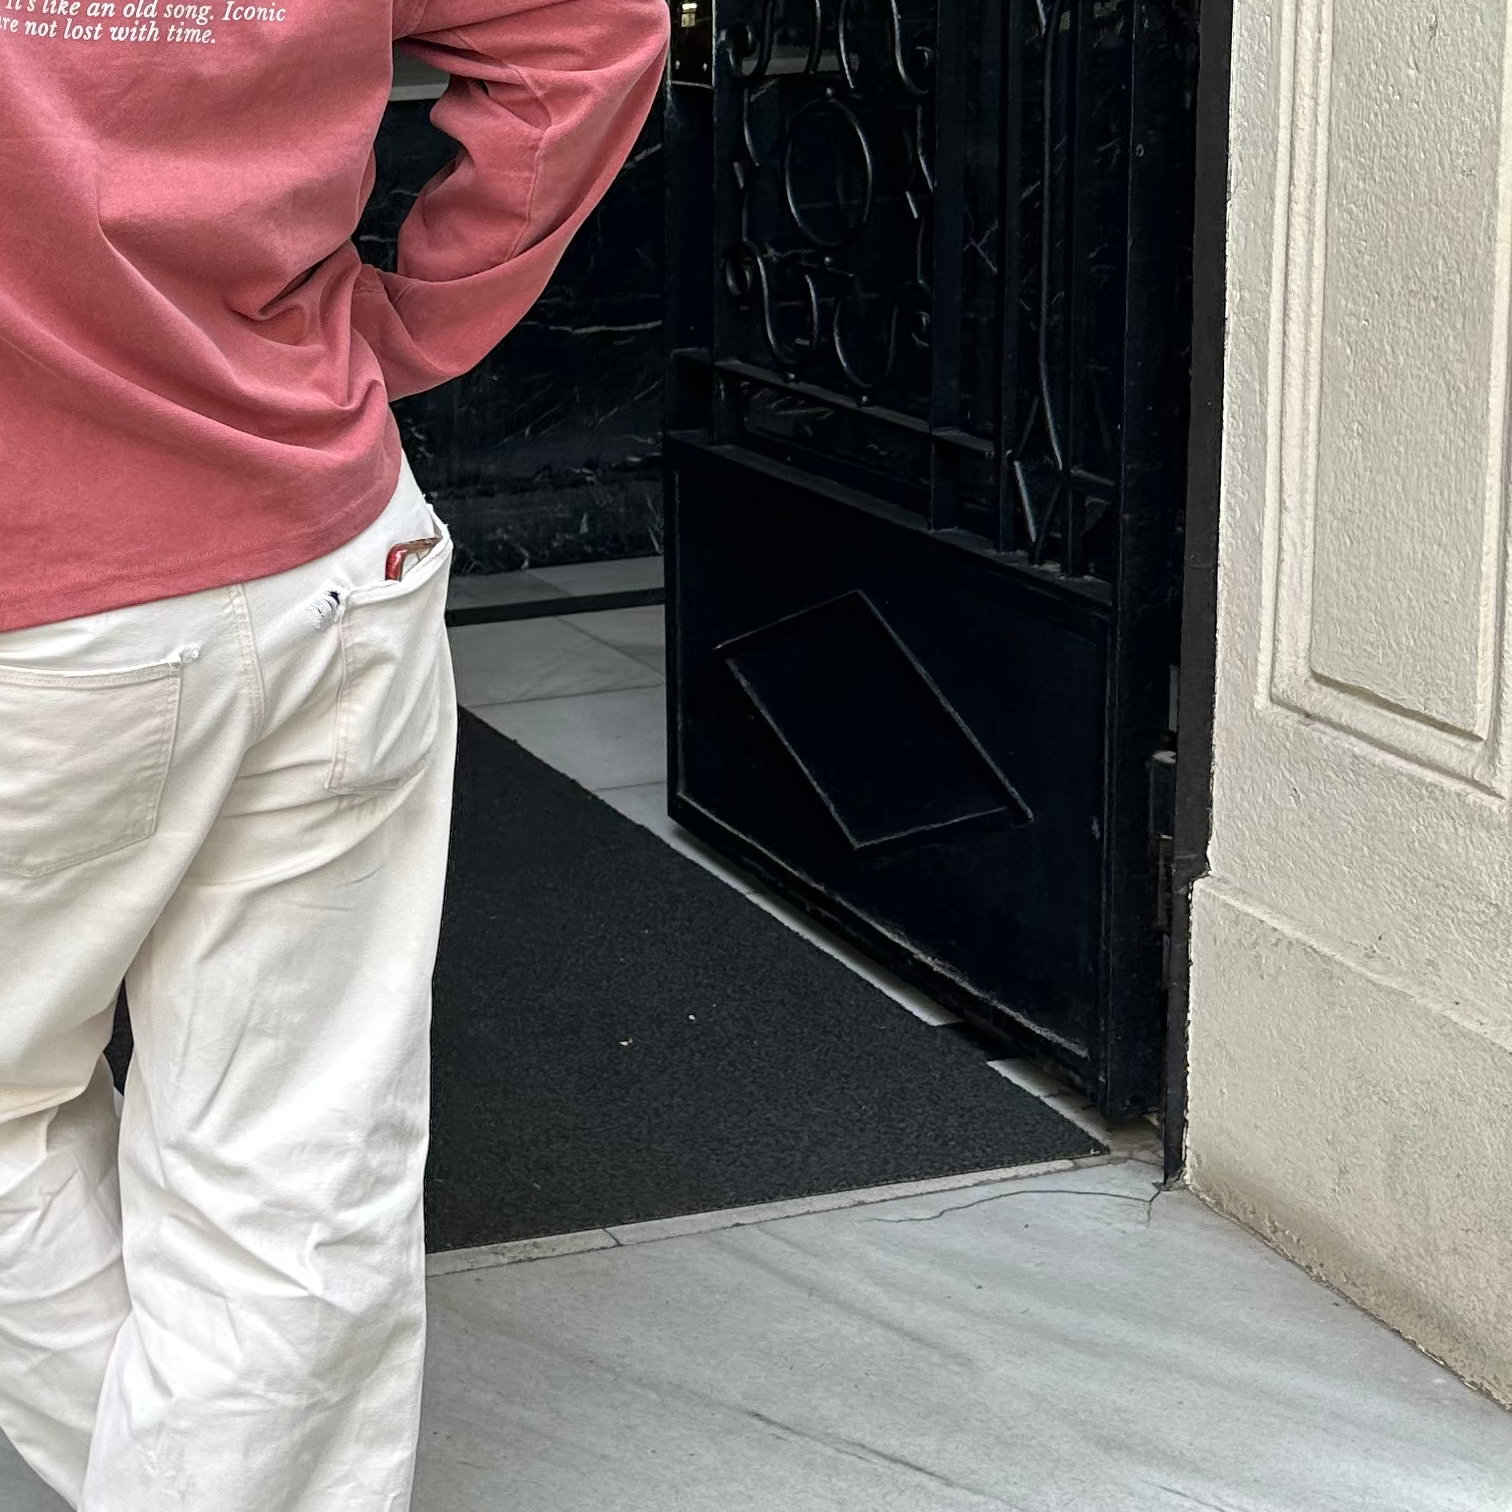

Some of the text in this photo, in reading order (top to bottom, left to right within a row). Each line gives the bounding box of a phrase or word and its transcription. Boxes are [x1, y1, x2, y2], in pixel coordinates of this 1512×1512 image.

[87, 2, 115, 17] an
[164, 3, 214, 25] song.
[222, 1, 287, 21] Iconic
[25, 19, 57, 37] not
[64, 18, 103, 40] lost
[110, 20, 159, 41] with
[167, 22, 216, 44] time.
